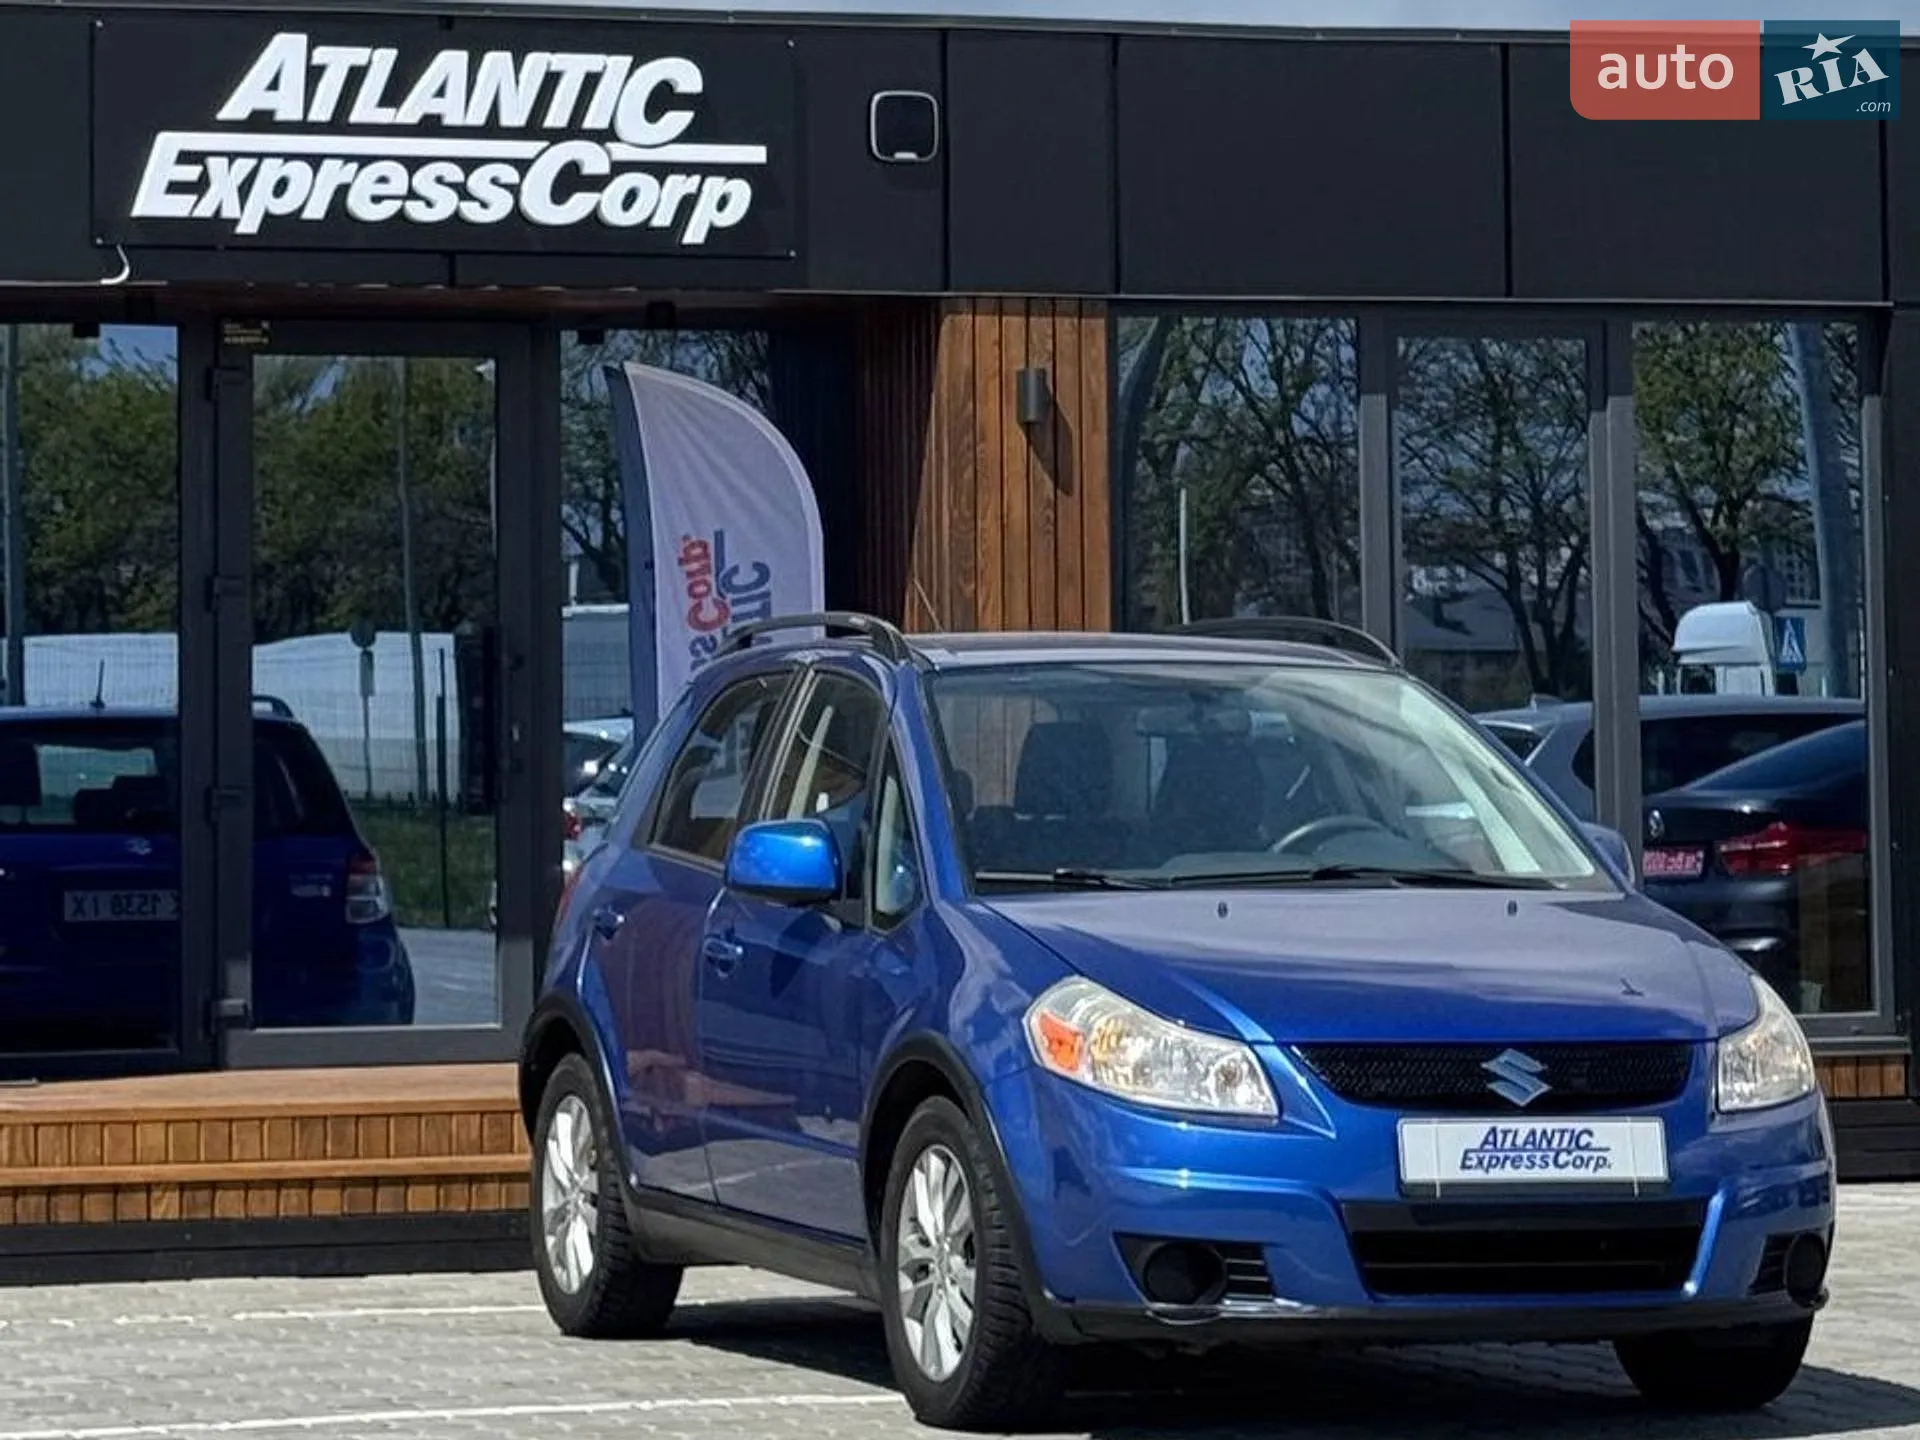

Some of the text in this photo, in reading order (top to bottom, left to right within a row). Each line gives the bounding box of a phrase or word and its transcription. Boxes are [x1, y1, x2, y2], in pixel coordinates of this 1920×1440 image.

[216, 32, 702, 145] ATLANTIC
[131, 132, 752, 246] ExpressCorp
[1480, 1126, 1595, 1150] ATLANTIC
